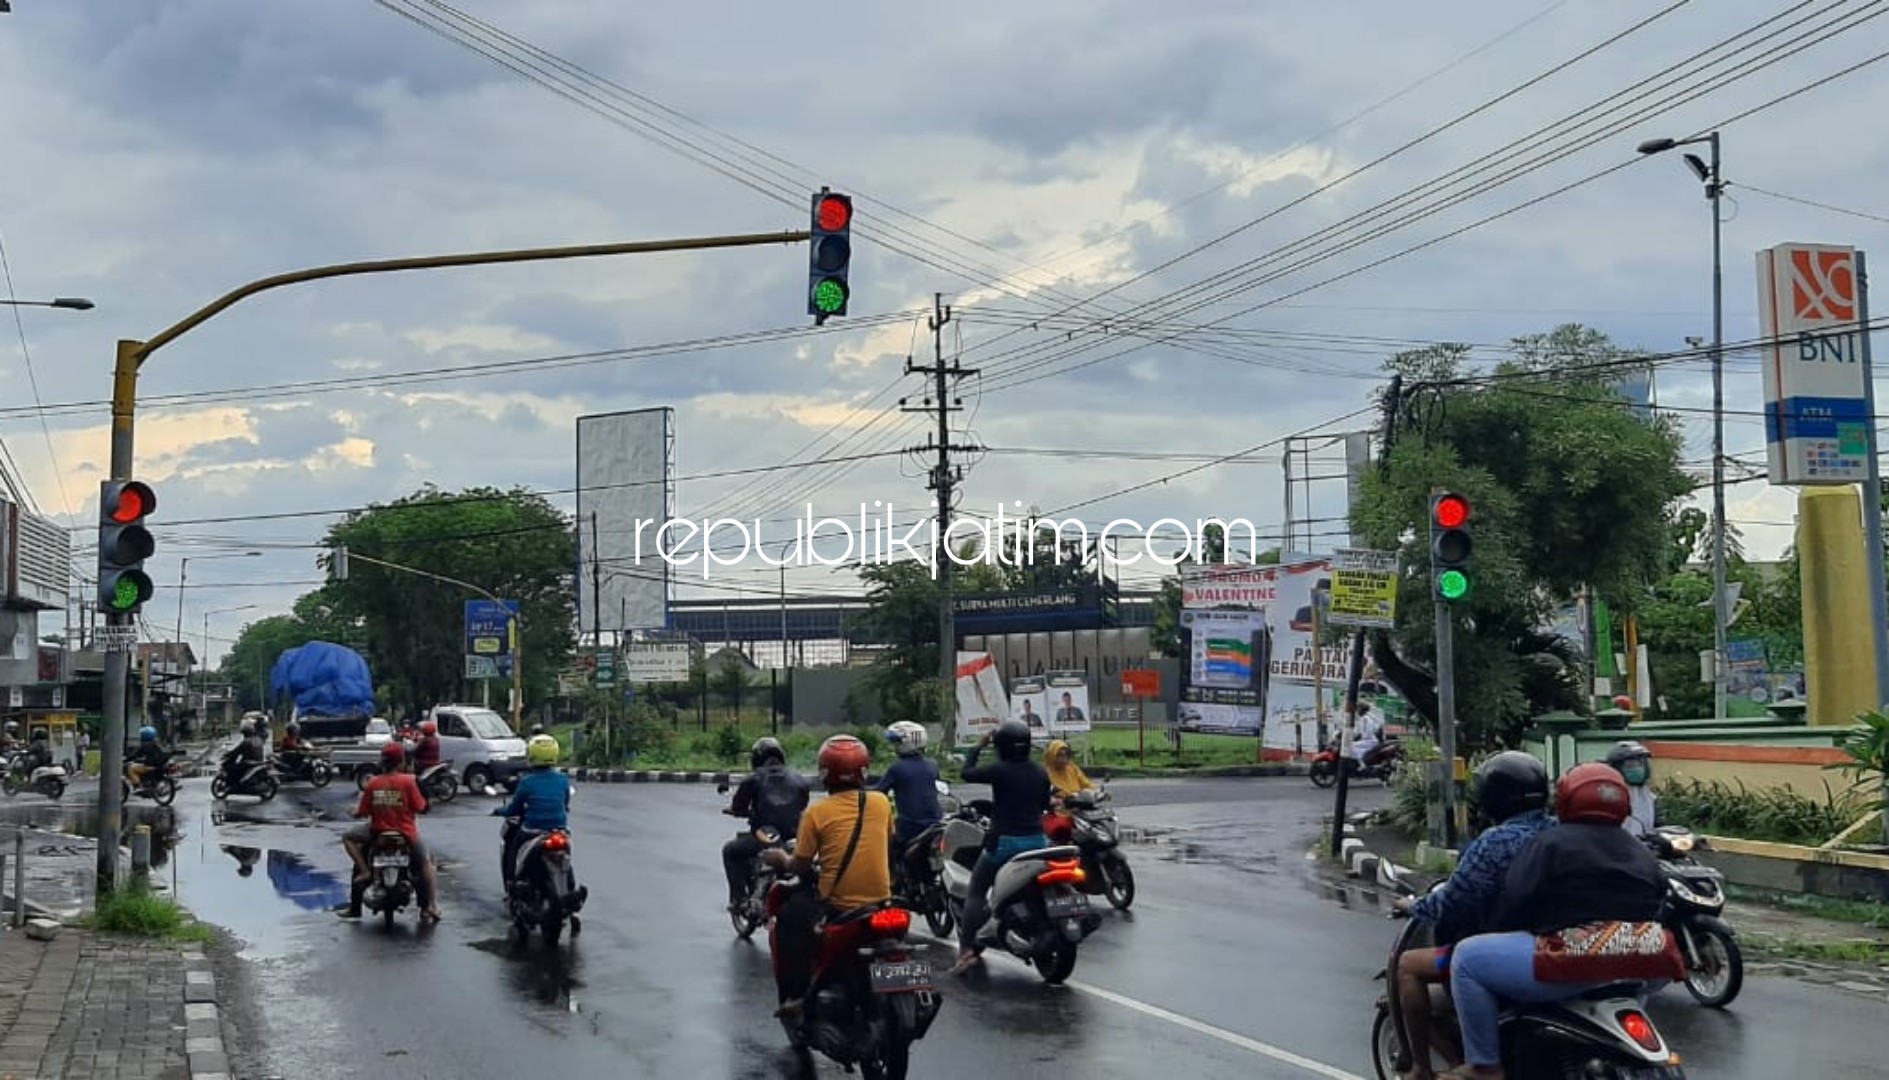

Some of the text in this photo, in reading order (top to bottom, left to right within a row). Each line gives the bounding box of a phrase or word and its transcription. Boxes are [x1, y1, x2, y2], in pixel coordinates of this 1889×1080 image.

[1799, 331, 1856, 363] BNI
[1802, 407, 1832, 417] ATM
[1194, 587, 1277, 602] VALENTINE
